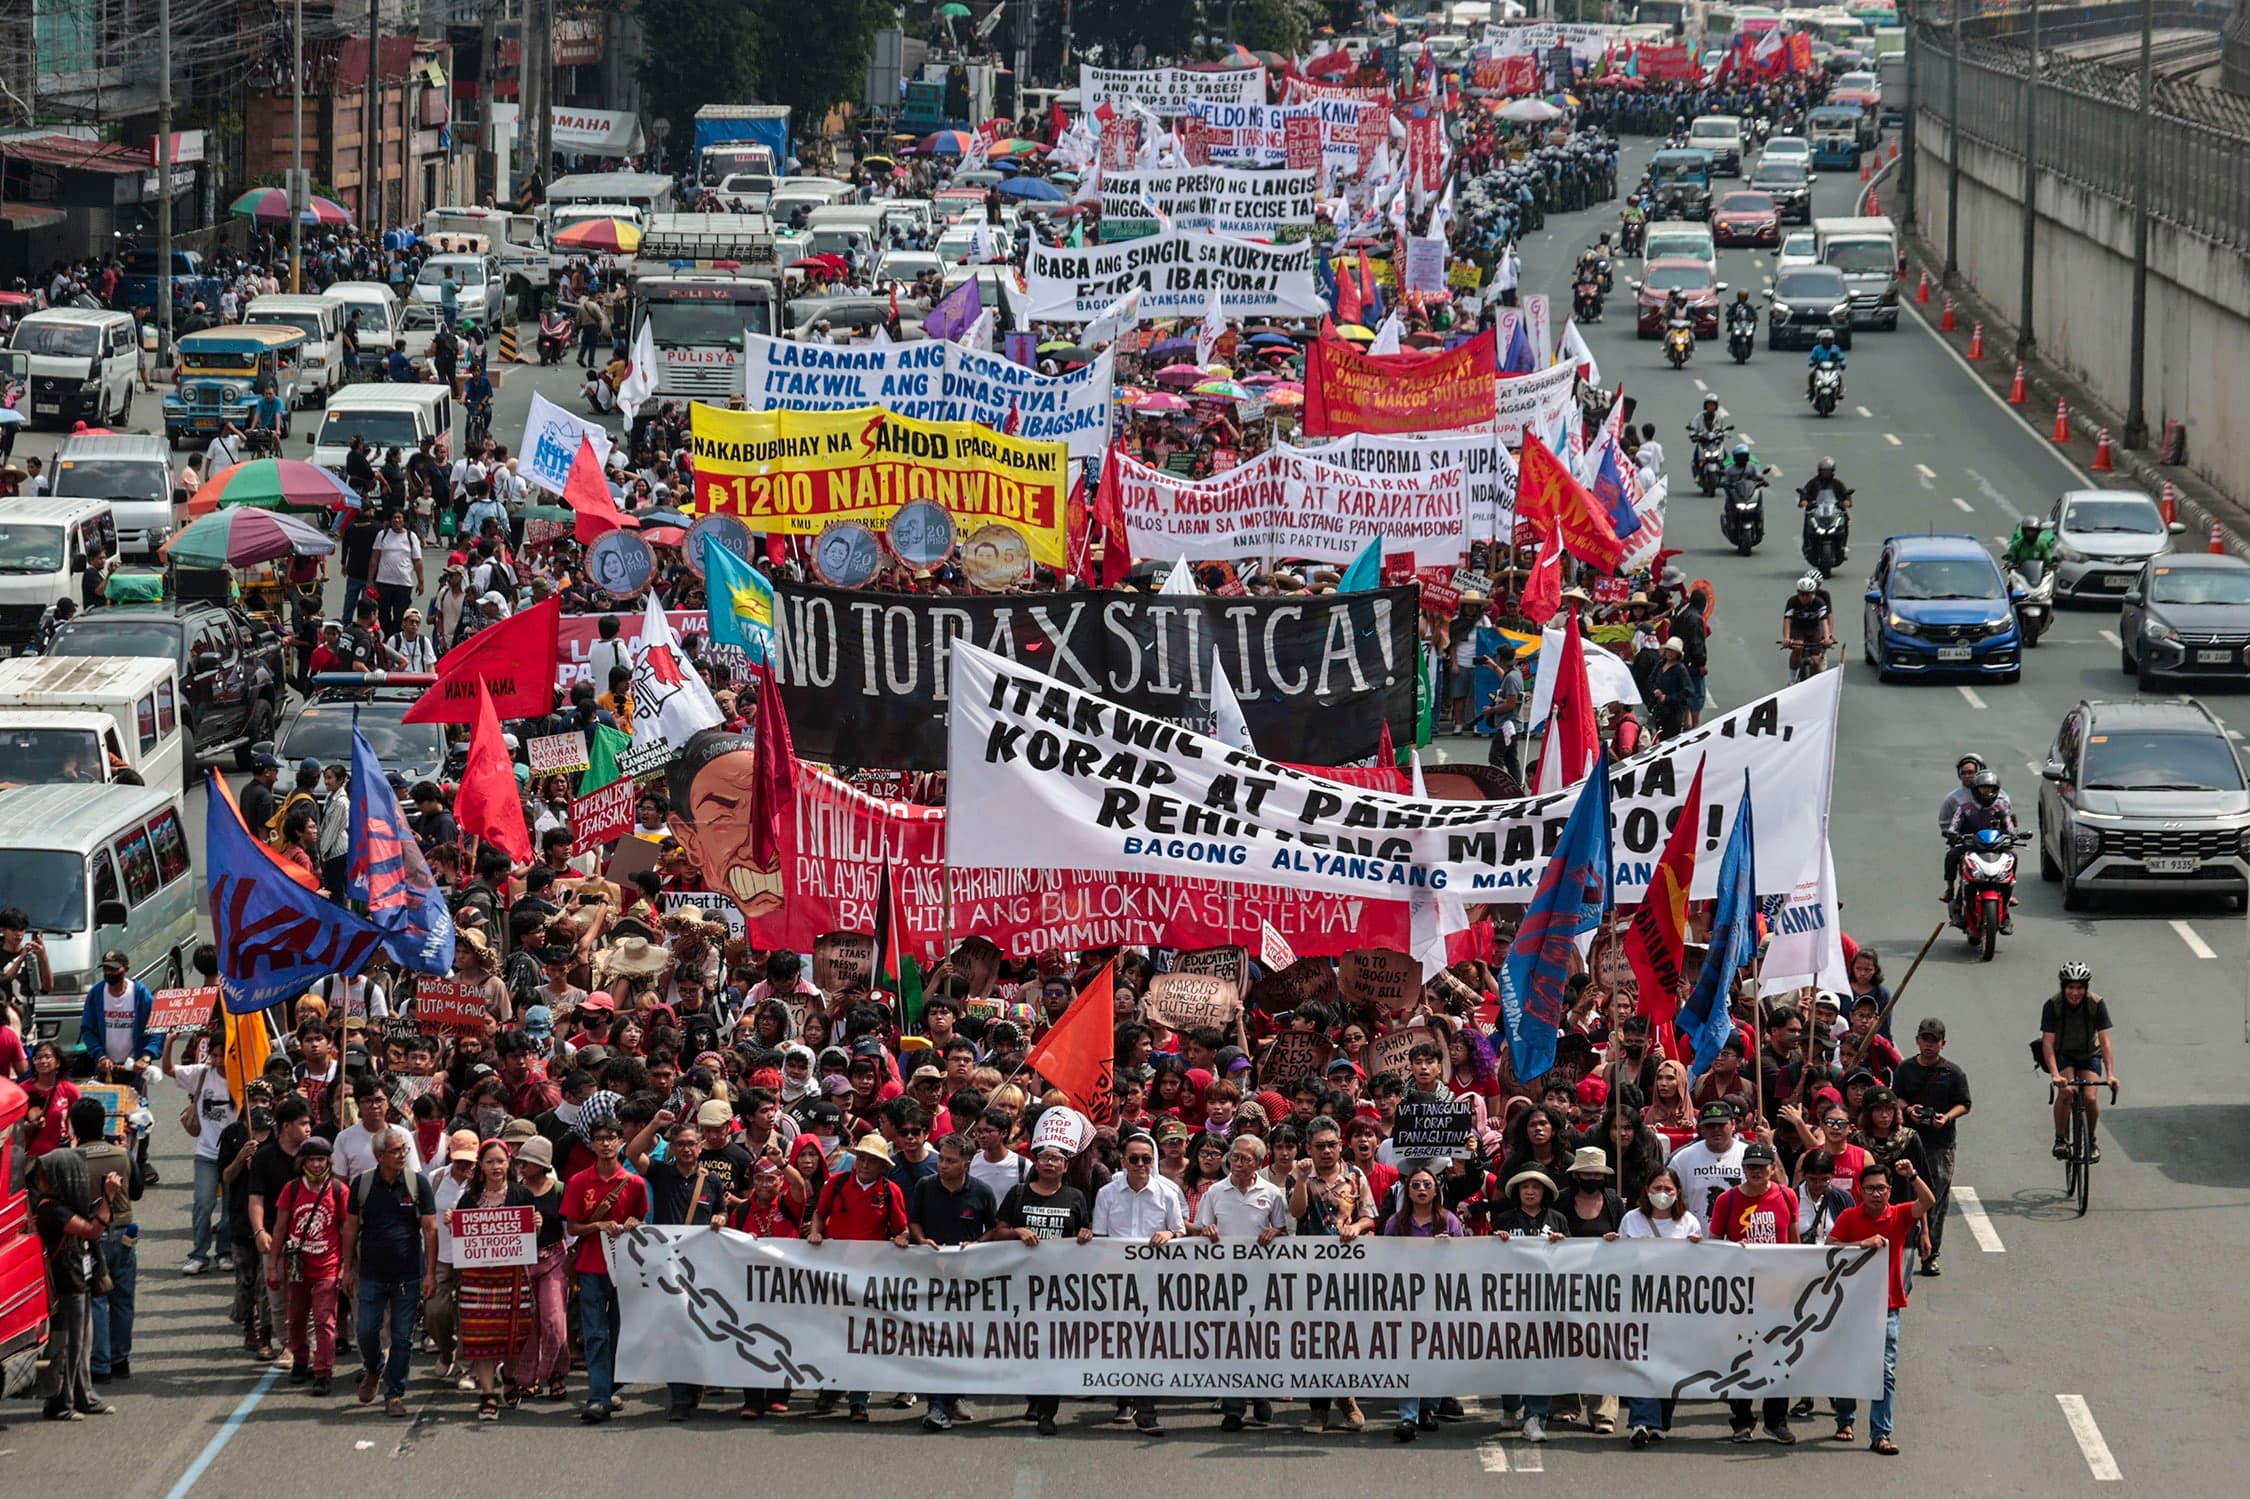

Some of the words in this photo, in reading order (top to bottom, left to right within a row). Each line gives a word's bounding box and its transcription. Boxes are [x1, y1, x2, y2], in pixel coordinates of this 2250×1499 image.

[1091, 71, 1162, 82] DISMANTLE
[1103, 83, 1129, 93] AND
[1136, 83, 1159, 94] ALL
[1186, 100, 1246, 128] SWELDO
[1287, 120, 1319, 138] 50K
[1332, 126, 1359, 141] 36K
[1102, 176, 1141, 195] BABA
[1176, 174, 1224, 195] PRESYO
[1228, 181, 1246, 195] NG
[1252, 176, 1315, 195] LANGIS
[1102, 199, 1172, 218] TANGGAIN
[1176, 201, 1195, 215] ANG
[1199, 199, 1216, 217] VAT
[1219, 202, 1231, 215] AT
[1234, 200, 1286, 218] EXCISE
[1033, 252, 1090, 279] IBABA
[1095, 255, 1122, 275] ANG
[1127, 239, 1194, 271] SINGIL
[1200, 246, 1217, 262] SA
[1076, 295, 1117, 311] BAGON
[667, 351, 736, 364] PULISYA
[767, 342, 886, 371] LABANAN
[898, 344, 945, 369] ANG
[764, 370, 867, 397] ITAKWIL
[881, 373, 929, 396] ANG
[942, 372, 1069, 413] DINASTIYA!
[1020, 402, 1105, 437] IBAGSAK!
[693, 435, 820, 463] NAKABUBUHAY
[827, 432, 852, 453] NA
[860, 414, 949, 460] SAHOD
[956, 437, 1057, 472] IPAGLABAN!
[1352, 447, 1421, 474] REPORMA
[1428, 467, 1462, 491] ANG
[829, 463, 1042, 526] NATIONWIDE
[1120, 484, 1168, 516] UPA,
[1174, 481, 1288, 514] KABUHAYAN,
[1301, 487, 1326, 513] AT
[1338, 489, 1462, 518] KARAPATAN!
[790, 517, 811, 530] KMU
[1168, 518, 1210, 534] LABAN
[1215, 516, 1235, 533] SA
[1240, 512, 1344, 533] IMPERYALISTANG
[1349, 519, 1464, 538] PANDARAMBONG!
[1289, 535, 1359, 553] PARTYLIST
[774, 592, 838, 689] NO
[850, 602, 918, 697] TO
[1104, 599, 1398, 706] SILICA!
[988, 671, 1204, 760] ITAKWIL
[532, 736, 564, 751] STATE
[538, 754, 582, 770] ADDRESS
[984, 717, 1177, 788] KORAP
[1203, 773, 1277, 817] AT
[577, 800, 634, 843] IBAGSAK!
[1447, 803, 1725, 867] MAROS!
[1123, 836, 1247, 865] BAGONG
[1272, 847, 1448, 891] ALYANSANG
[1471, 861, 1652, 890] MAKAN
[796, 856, 883, 902] PALAYASI
[901, 866, 945, 906] ANG
[668, 893, 710, 908] What
[839, 900, 955, 932] BAHIN
[969, 897, 1031, 929] ANG
[1041, 884, 1142, 925] BULOK
[1148, 886, 1198, 923] NA
[1203, 894, 1363, 934] SISTEMA!
[1011, 920, 1166, 957] COMMUNITY
[1183, 951, 1239, 966] EDUCATION
[1372, 956, 1387, 968] TO
[417, 980, 454, 996] MARCOS
[416, 998, 444, 1014] TUTA
[456, 1003, 486, 1017] KANO
[1398, 1104, 1419, 1116] VAT
[1042, 1119, 1072, 1128] STOP
[1045, 1127, 1066, 1135] THE
[1414, 1116, 1453, 1129] KORAP
[1398, 1130, 1469, 1144] PANAGUTIN!
[1694, 1164, 1741, 1178] nothing
[461, 1210, 521, 1224] DISMANTLE
[1026, 1215, 1047, 1227] FREE
[1049, 1216, 1064, 1228] ALL
[462, 1223, 479, 1236] US
[481, 1221, 522, 1234] BASES!
[464, 1238, 478, 1248] US
[480, 1235, 522, 1247] TROOPS
[464, 1248, 488, 1260] OUT
[491, 1246, 523, 1258] NOW!
[1124, 1244, 1188, 1261] SONA
[1194, 1244, 1223, 1261] NG
[1227, 1244, 1308, 1261] BAYAN
[1313, 1244, 1366, 1261] 2026
[746, 1264, 855, 1307] ITAKWIL
[863, 1275, 918, 1311] ANG
[927, 1275, 1021, 1315] PAPET,
[1028, 1273, 1148, 1315] PASISTA,
[1157, 1273, 1256, 1315] KORAP,
[1264, 1273, 1298, 1311] AT
[1306, 1273, 1426, 1312] PAHIRAP
[1434, 1274, 1470, 1312] NA
[1484, 1274, 1622, 1313] REHIMENG
[1631, 1275, 1756, 1315] MARCOS!
[847, 1316, 976, 1359] LABANAN
[983, 1321, 1040, 1360] ANG
[1049, 1320, 1281, 1361] IMPERYALISTANG
[1294, 1321, 1361, 1360] GERA
[1368, 1321, 1403, 1360] AT
[1411, 1321, 1650, 1362] PANDARAMBONG!
[1081, 1371, 1165, 1390] BAGONG
[1169, 1371, 1286, 1390] ALYANSANG
[1289, 1371, 1411, 1390] MAKABAYAN
